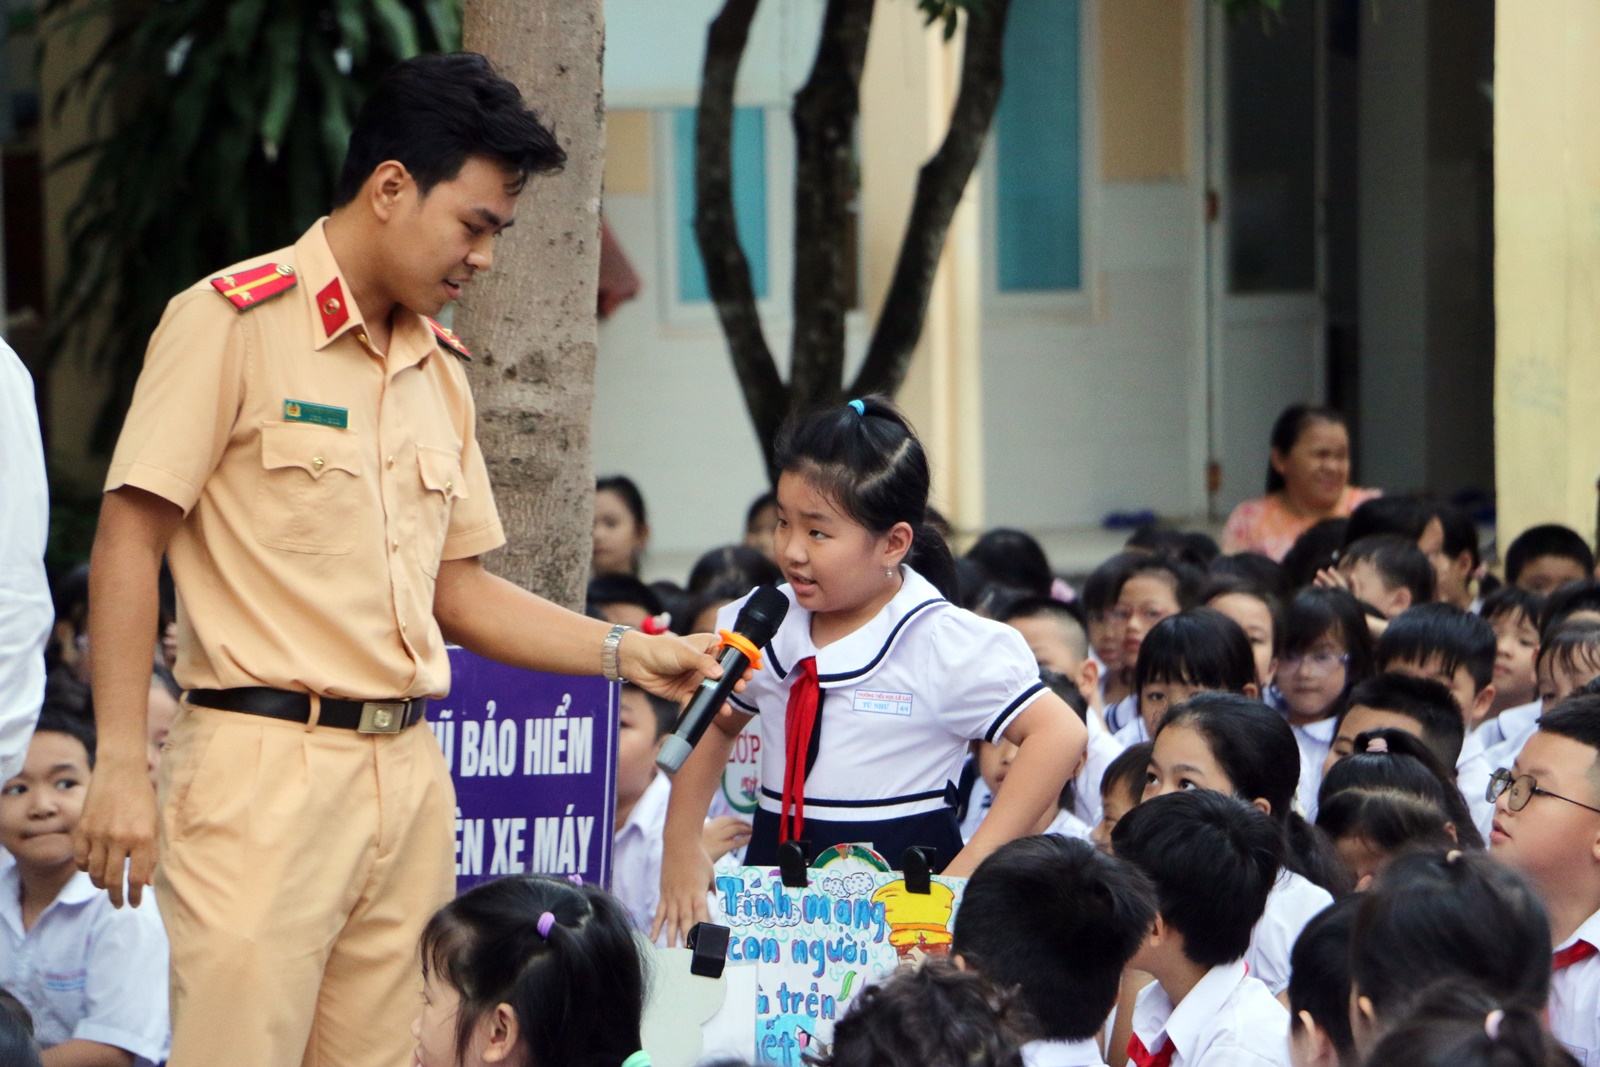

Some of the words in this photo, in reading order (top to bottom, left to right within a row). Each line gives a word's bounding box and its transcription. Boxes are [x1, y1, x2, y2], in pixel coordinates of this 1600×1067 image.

[874, 702, 890, 710] NHƯ
[460, 700, 518, 777] BẢO
[523, 693, 594, 775] HIỂM
[489, 818, 527, 875] XE
[533, 804, 594, 874] MÁY
[716, 876, 793, 919] Tính
[803, 893, 886, 944] mạng
[727, 936, 780, 963] con
[791, 932, 868, 978] người
[776, 982, 836, 1019] trên
